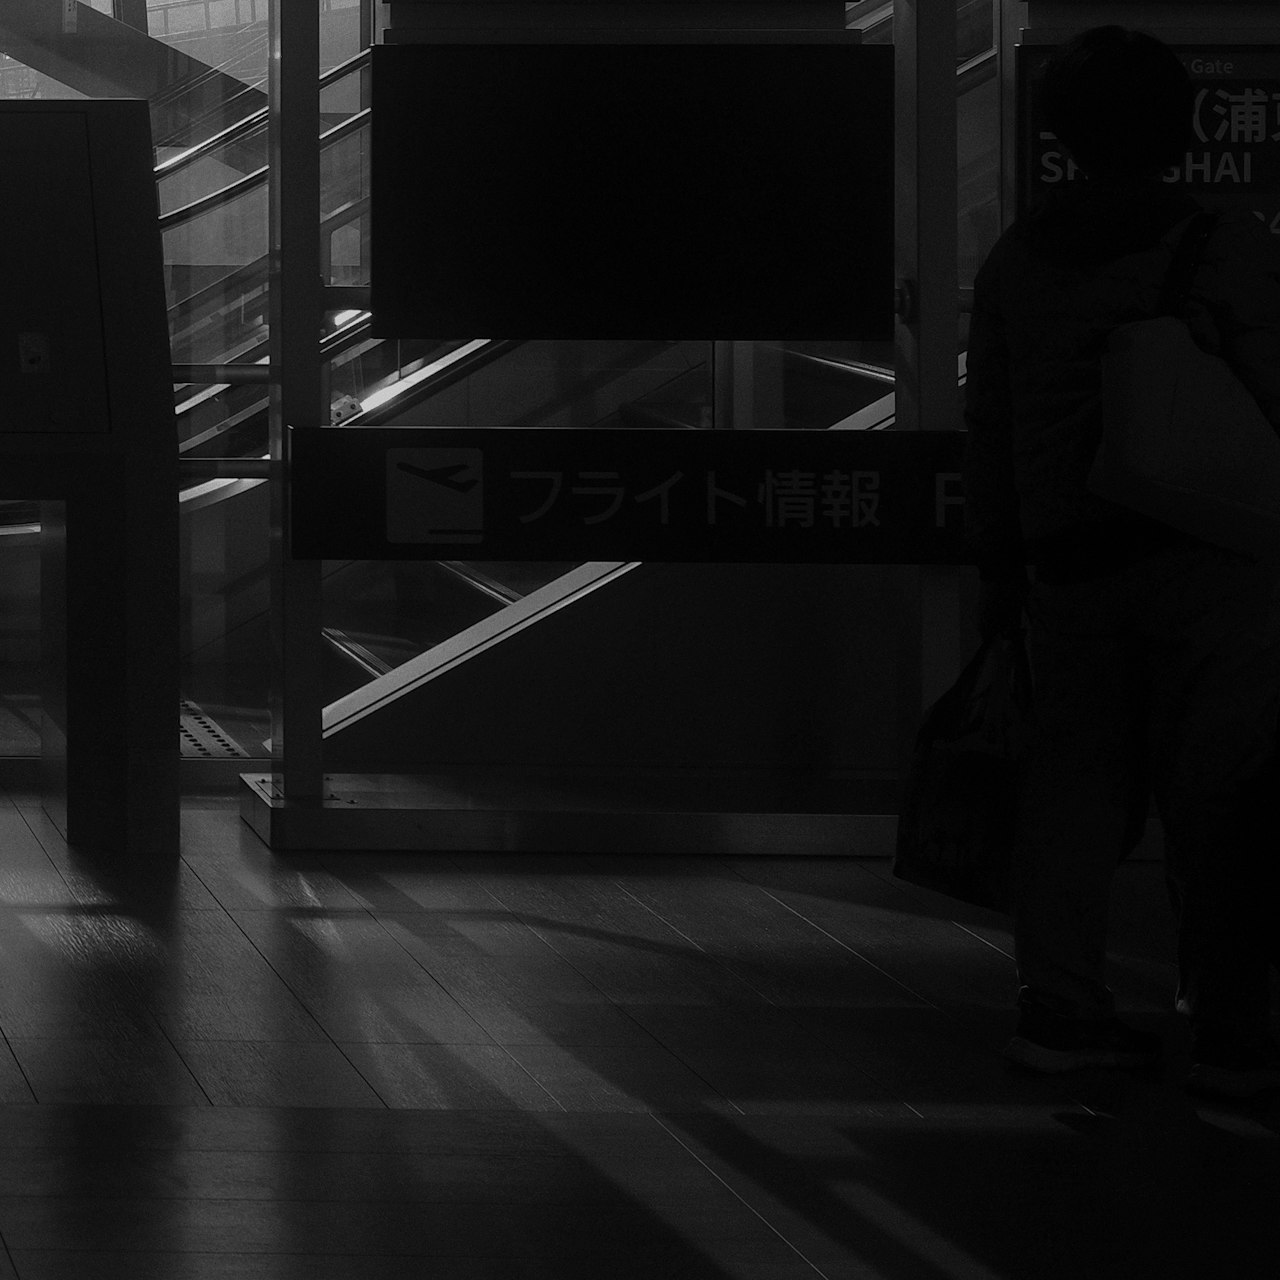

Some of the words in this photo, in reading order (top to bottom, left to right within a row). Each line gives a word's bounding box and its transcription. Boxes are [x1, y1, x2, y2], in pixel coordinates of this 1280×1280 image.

[1190, 58, 1234, 75] Gate
[1039, 150, 1252, 183] SHAI
[509, 468, 882, 529] フライト情報
